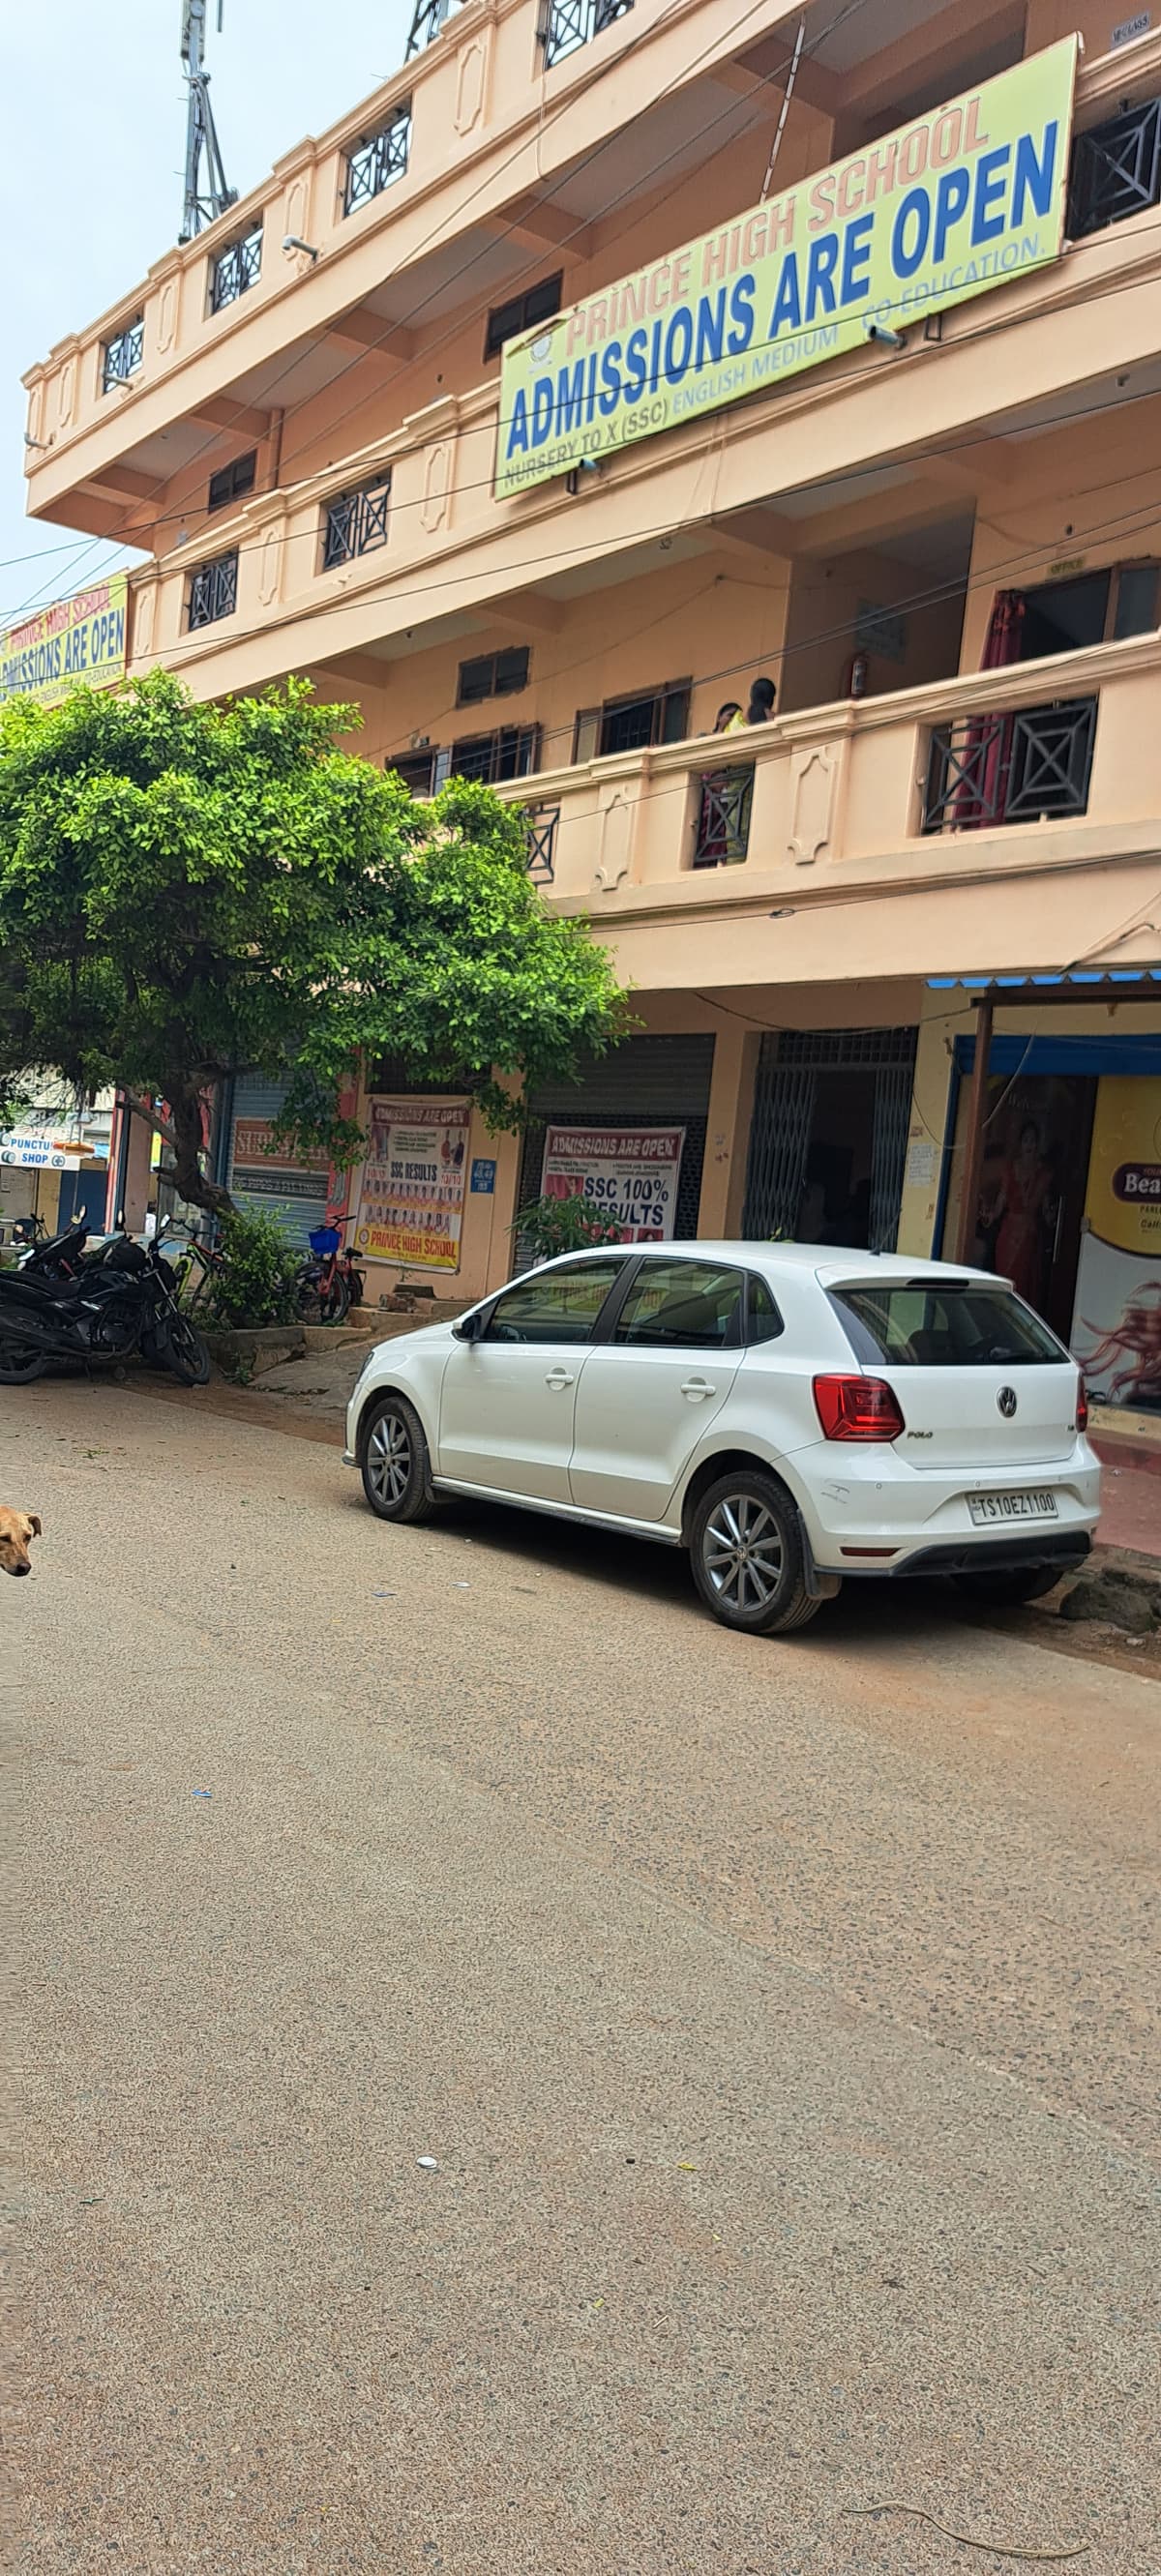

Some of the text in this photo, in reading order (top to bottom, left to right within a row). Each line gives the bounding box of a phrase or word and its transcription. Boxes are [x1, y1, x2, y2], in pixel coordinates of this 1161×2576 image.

[565, 95, 991, 357] PRINCE HIGH SCHOOL
[506, 120, 1059, 459] ADMISSIONS ARE OPEN
[504, 440, 577, 489] NURSERY
[581, 429, 603, 453] TO
[606, 423, 619, 441] X
[621, 398, 669, 442] (SSC)
[672, 361, 745, 414] ENGLISH
[752, 324, 839, 372] MEDIUM
[65, 624, 88, 673] ARE
[91, 607, 125, 665] OPEN
[440, 1110, 464, 1123] OPEN
[11, 1138, 53, 1150] PUNCTU
[551, 1136, 675, 1156] ADMISSIONS ARE OPEN
[21, 1152, 48, 1164] SHOP
[390, 1161, 437, 1182] SSC RESULTS
[584, 1176, 669, 1202] SSC 100%
[371, 1229, 402, 1251] PRINCE
[402, 1234, 422, 1254] HIGH
[424, 1238, 456, 1258] SCHOOL
[907, 1431, 934, 1439] POLO
[978, 1493, 1055, 1518] TS10EZ1100
